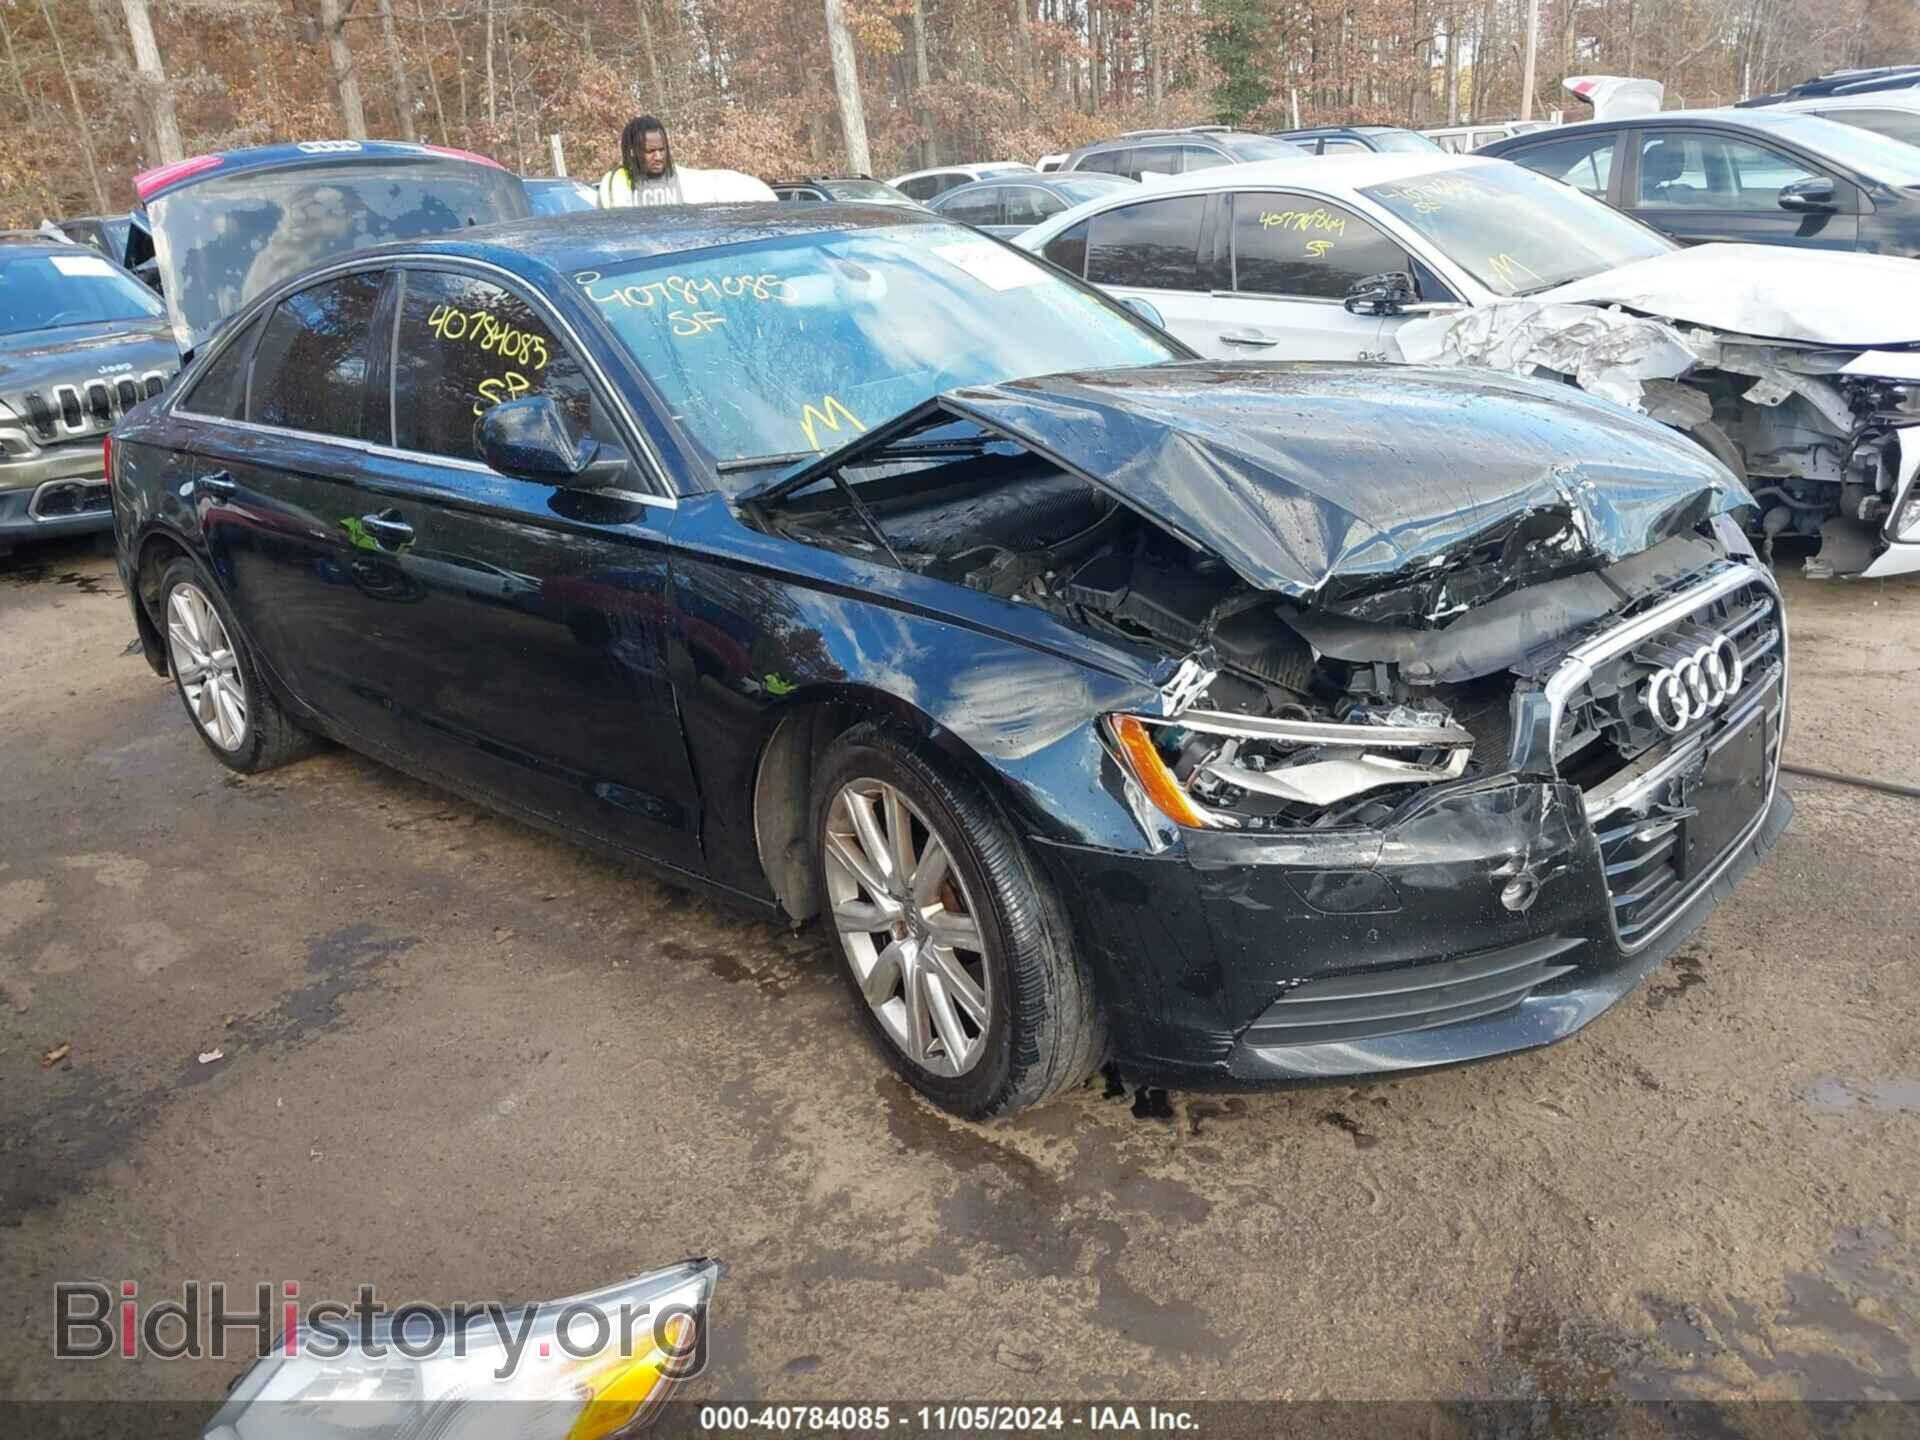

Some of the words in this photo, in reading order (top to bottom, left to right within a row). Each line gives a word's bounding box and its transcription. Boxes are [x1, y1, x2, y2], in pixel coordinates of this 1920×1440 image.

[577, 271, 798, 307] 40784085
[428, 304, 548, 370] 40784085
[668, 310, 727, 336] SF
[97, 362, 133, 374] Jeep
[800, 395, 868, 454] M
